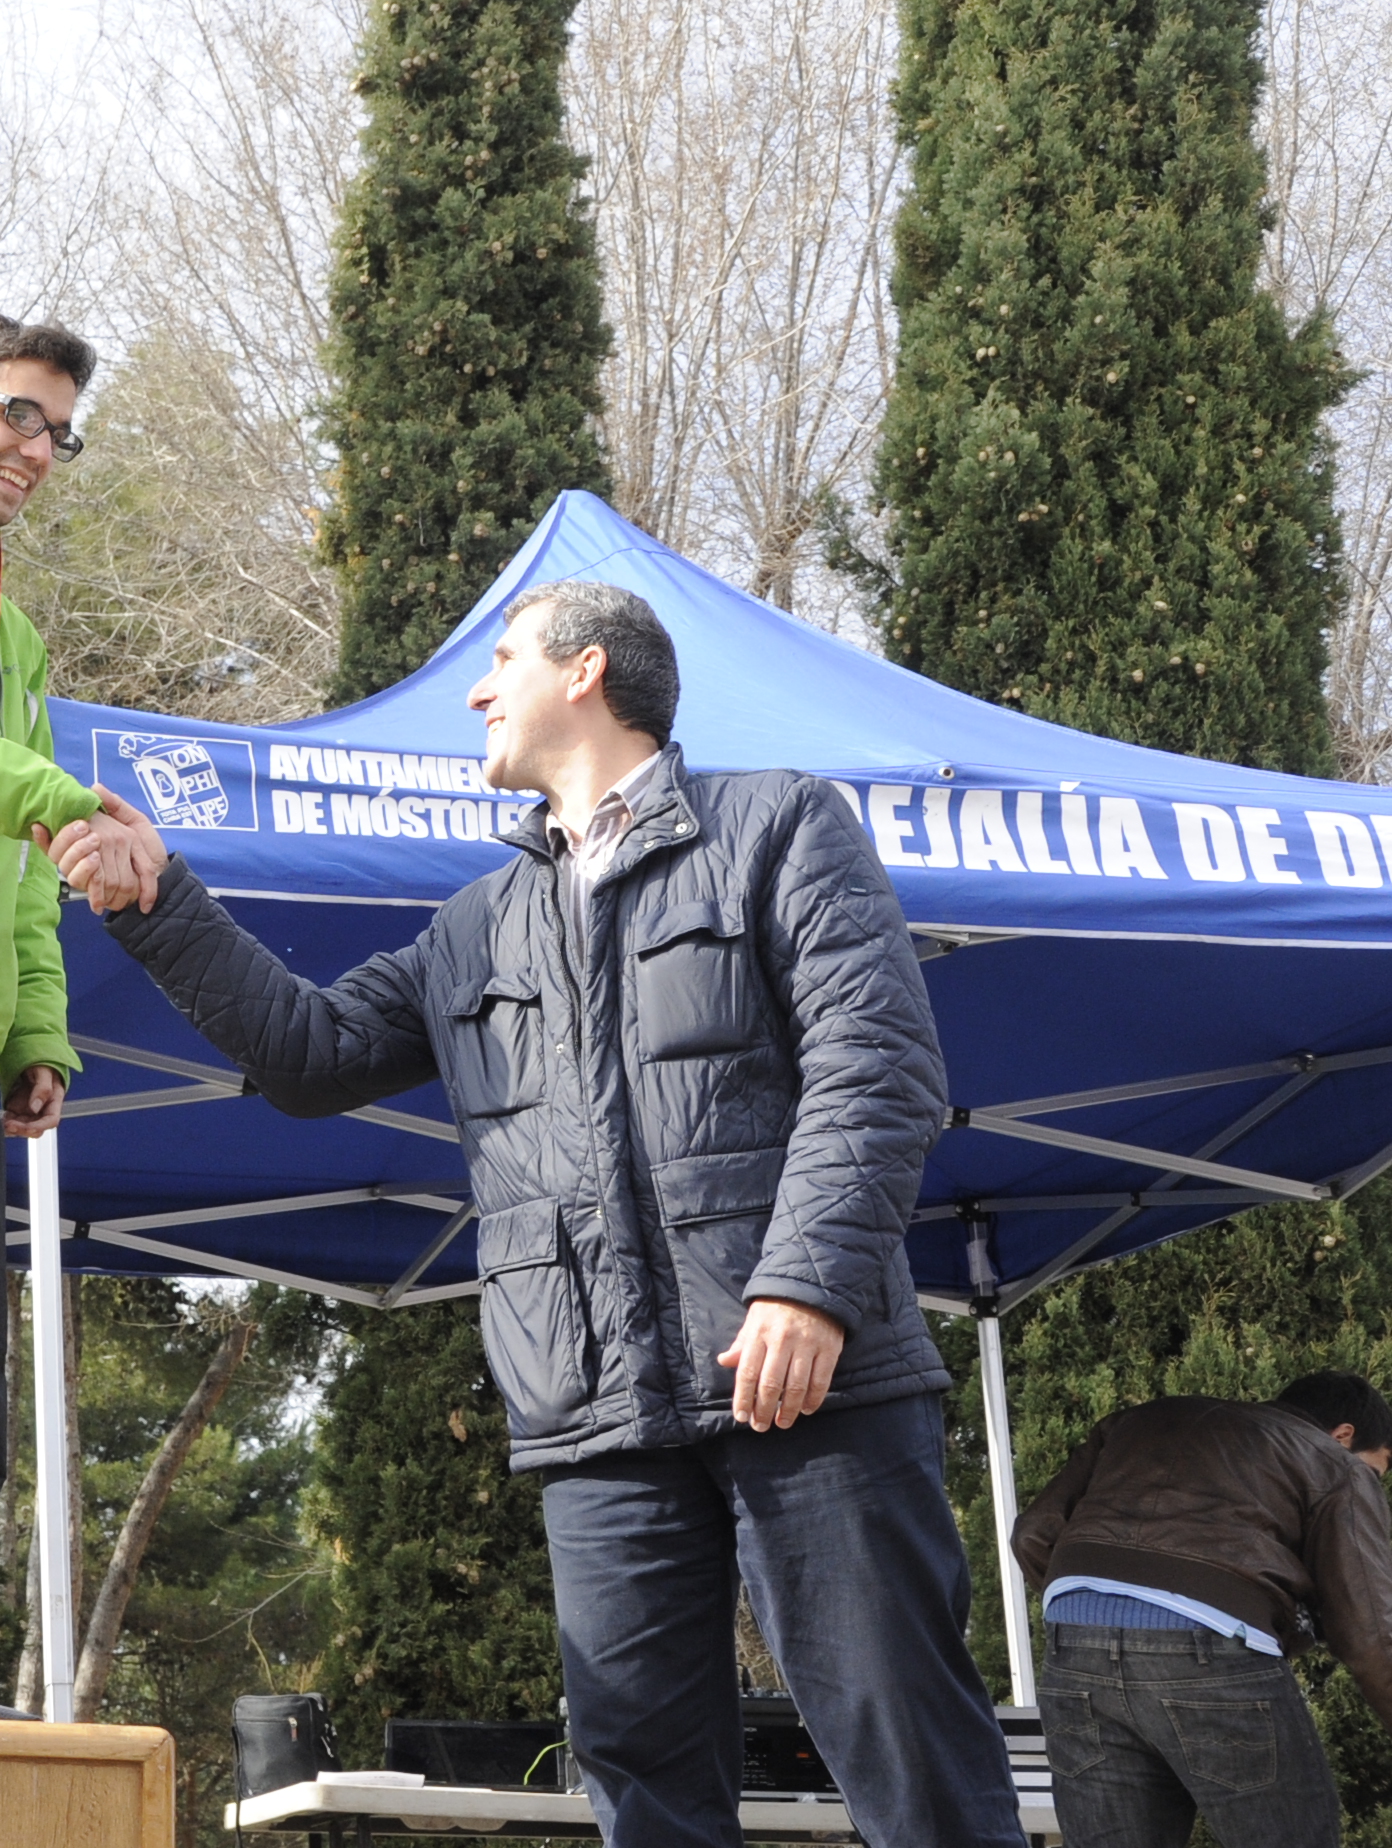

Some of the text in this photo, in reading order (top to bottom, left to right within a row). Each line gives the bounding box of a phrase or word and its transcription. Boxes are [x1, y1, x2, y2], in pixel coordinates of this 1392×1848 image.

[270, 744, 541, 799] AYUNTAMIEN
[271, 789, 328, 835] DE
[1171, 801, 1304, 886] DE
[1304, 810, 1392, 889] D
